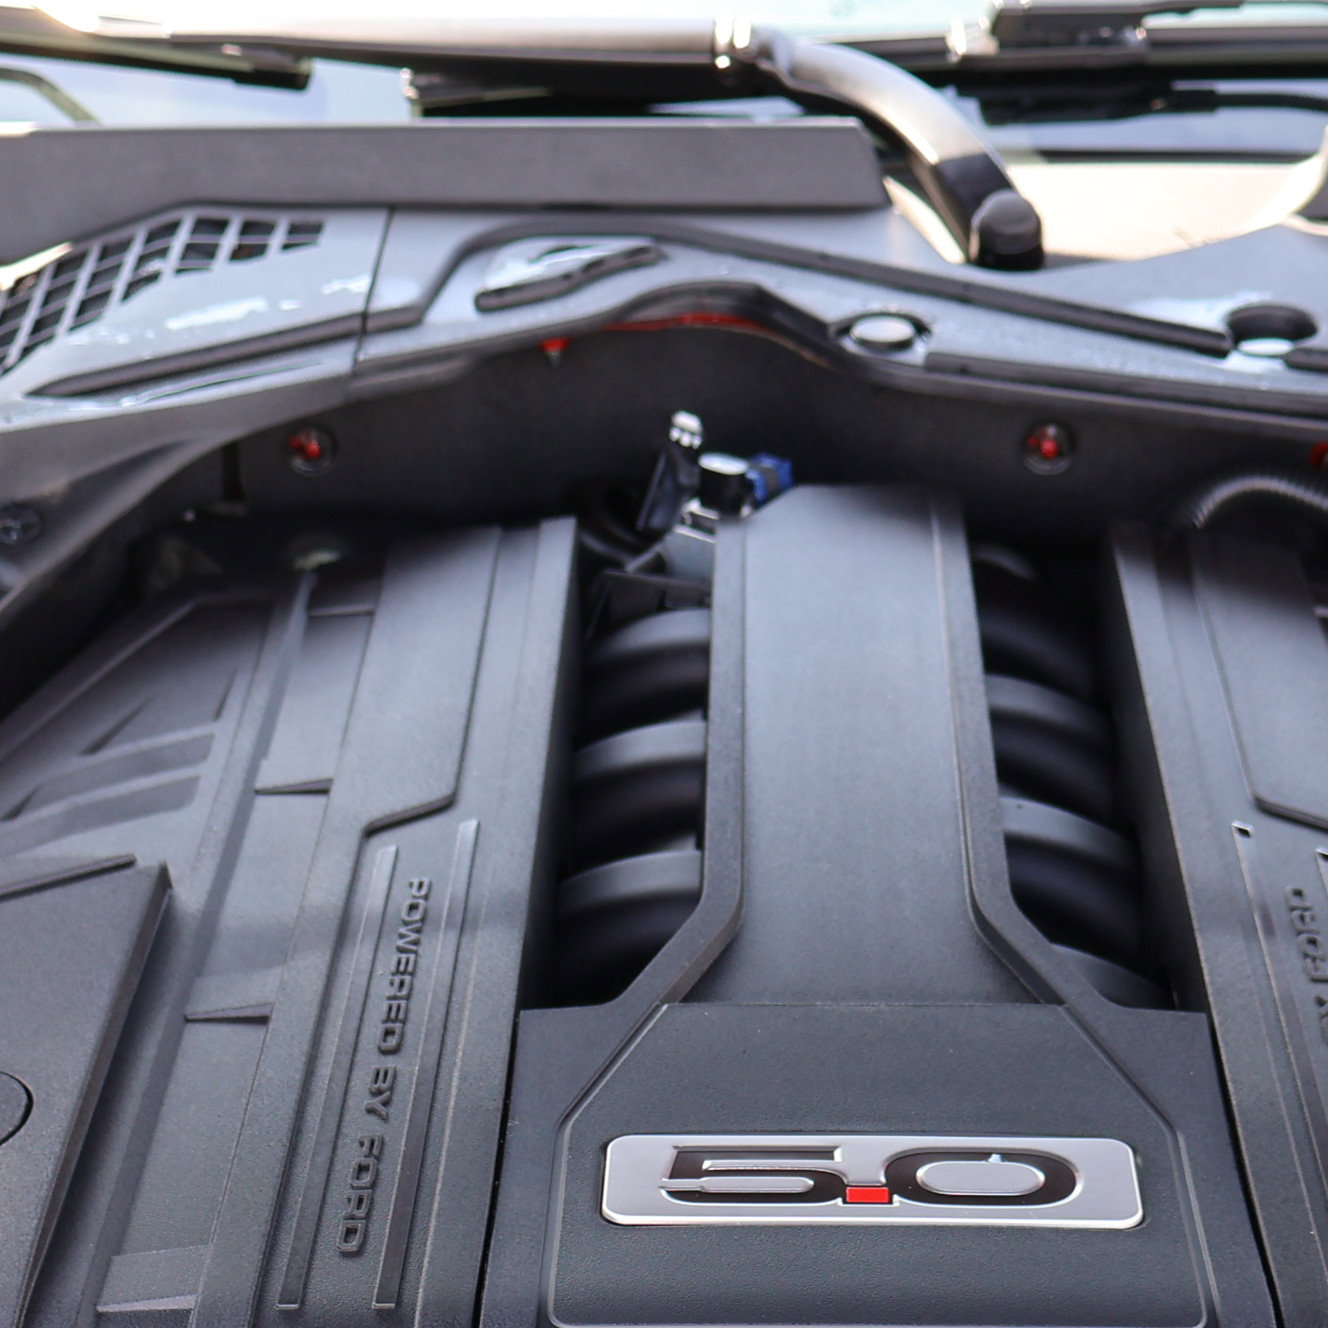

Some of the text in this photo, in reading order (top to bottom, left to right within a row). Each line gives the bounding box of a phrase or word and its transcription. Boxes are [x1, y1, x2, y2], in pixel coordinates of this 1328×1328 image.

[337, 876, 432, 1255] POWERED BY FORD
[658, 1144, 1082, 1207] 5.0
